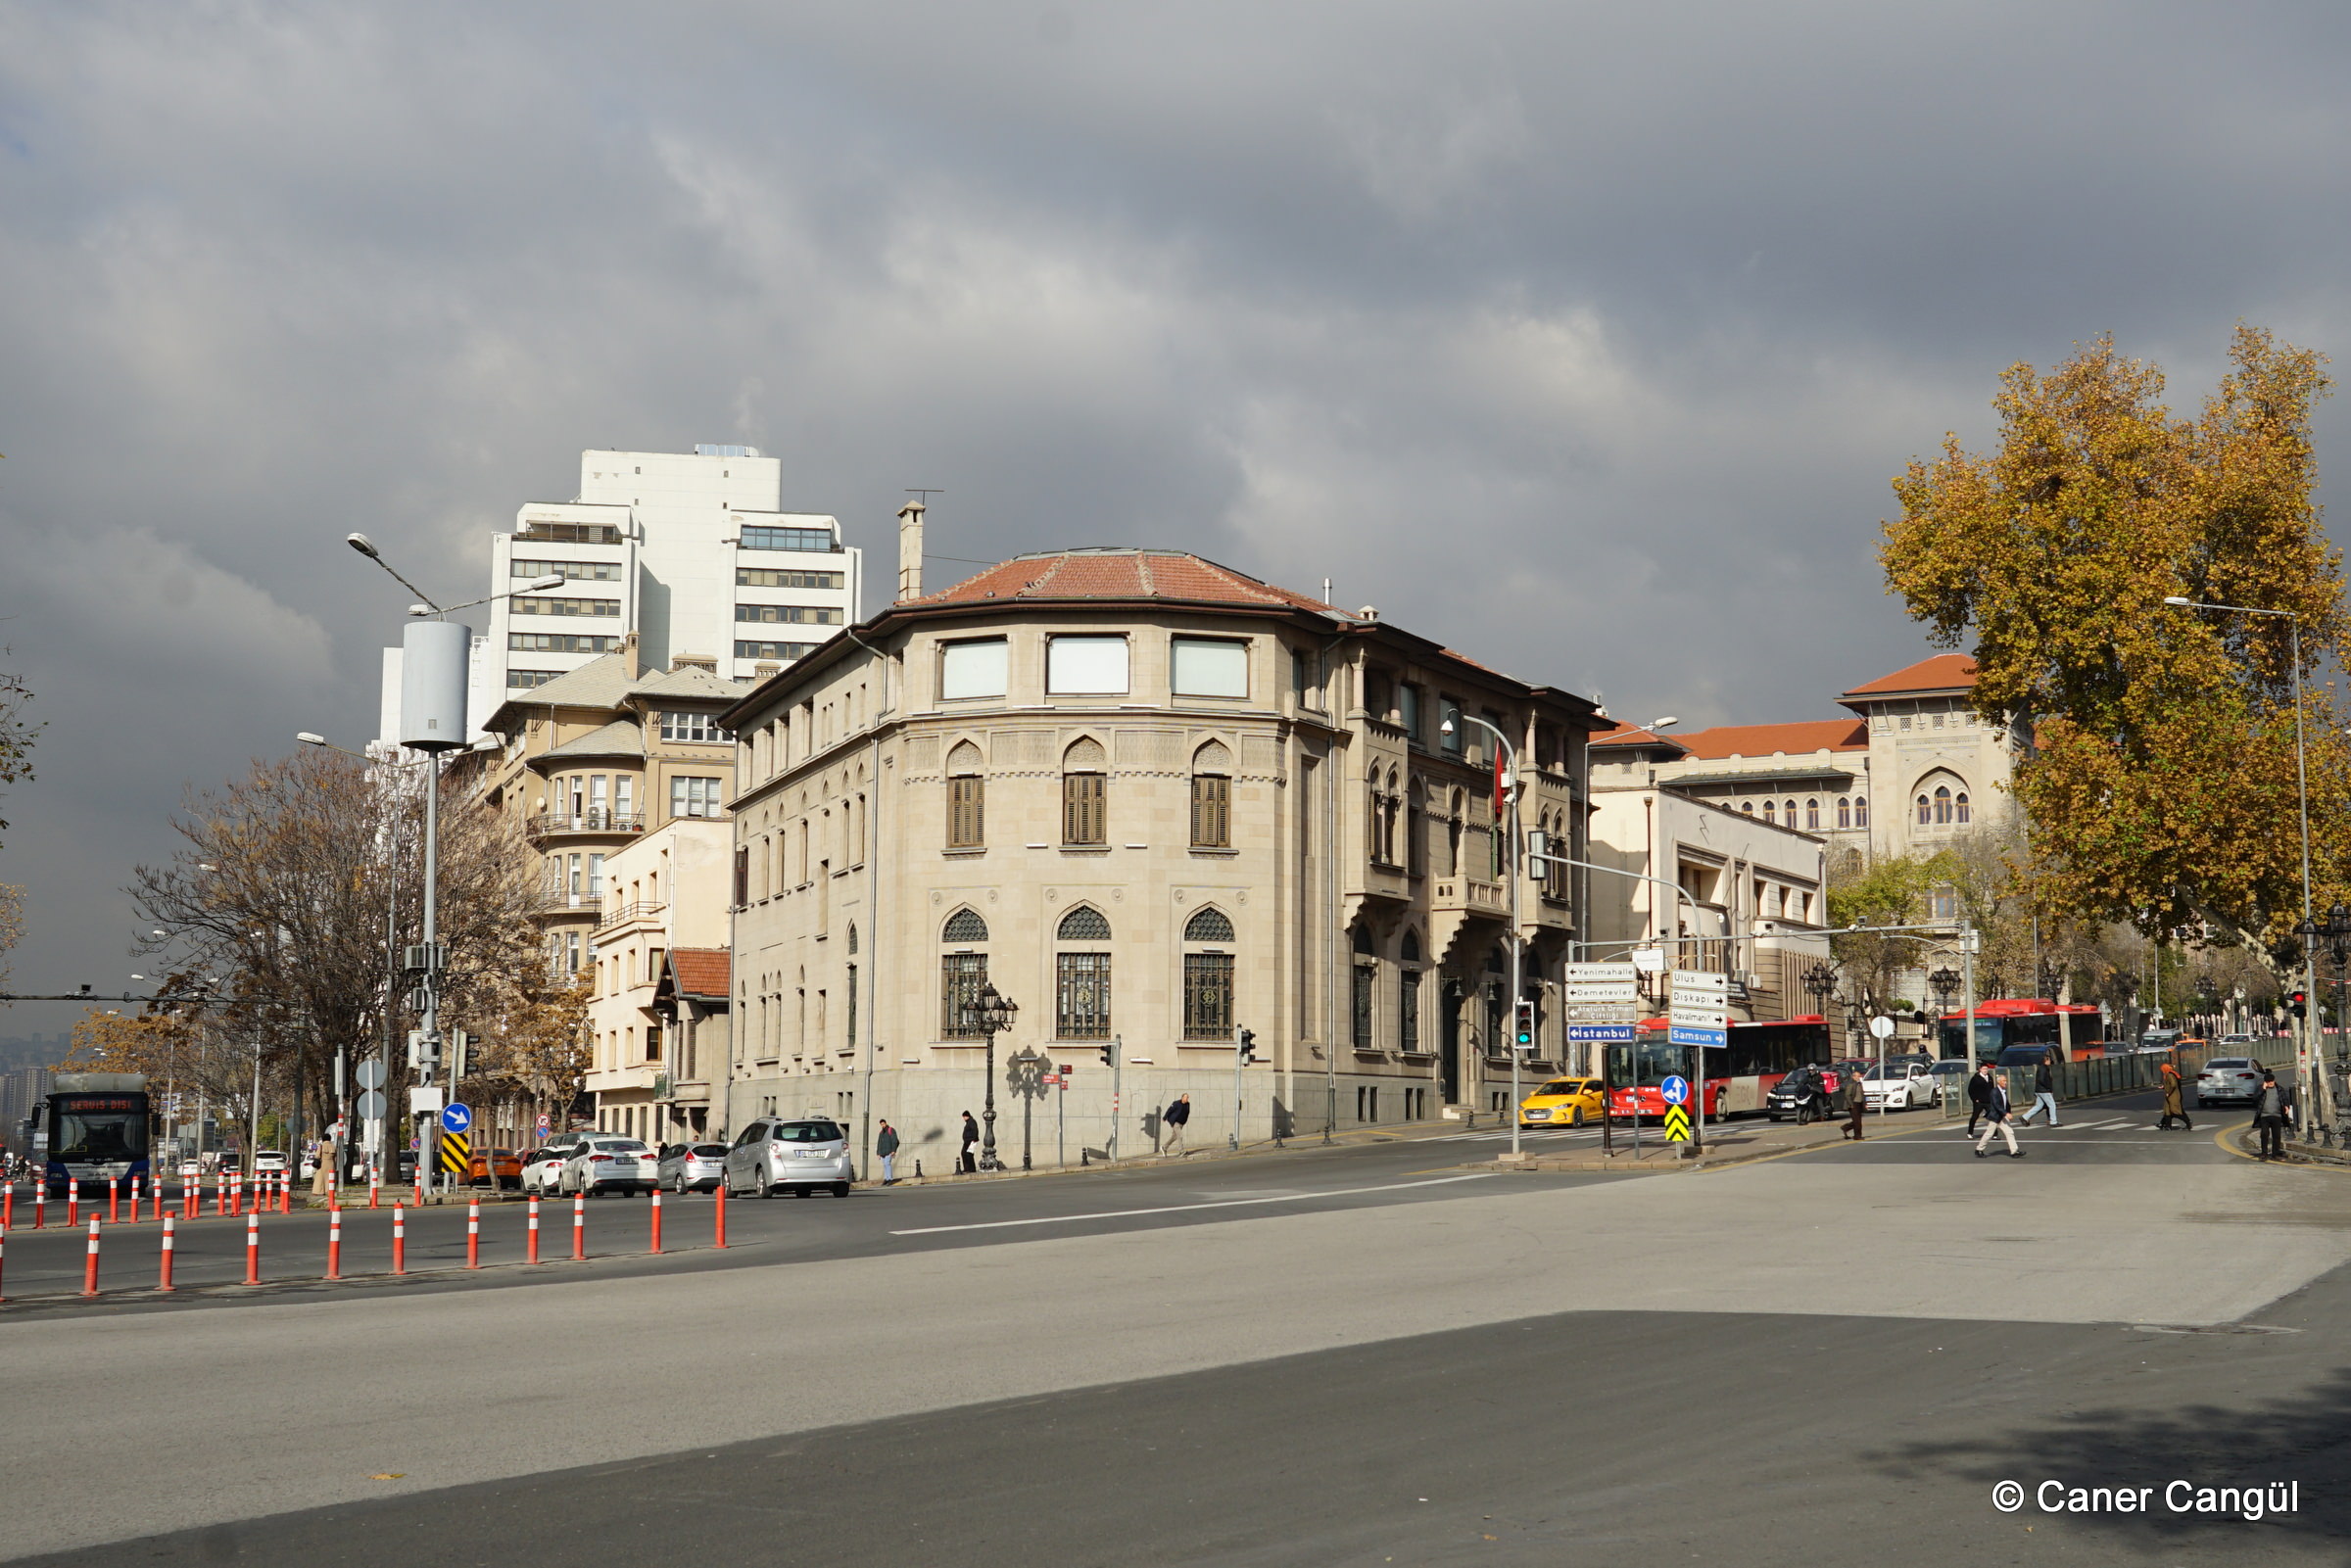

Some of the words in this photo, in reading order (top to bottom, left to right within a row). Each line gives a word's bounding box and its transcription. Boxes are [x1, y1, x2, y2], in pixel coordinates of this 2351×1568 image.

[1577, 968, 1633, 976] Yenimahalle
[1674, 973, 1696, 983] Ulus
[1577, 988, 1632, 997] Demetevler
[1578, 1026, 1630, 1038] İstanbul
[1672, 1029, 1712, 1042] Samsun
